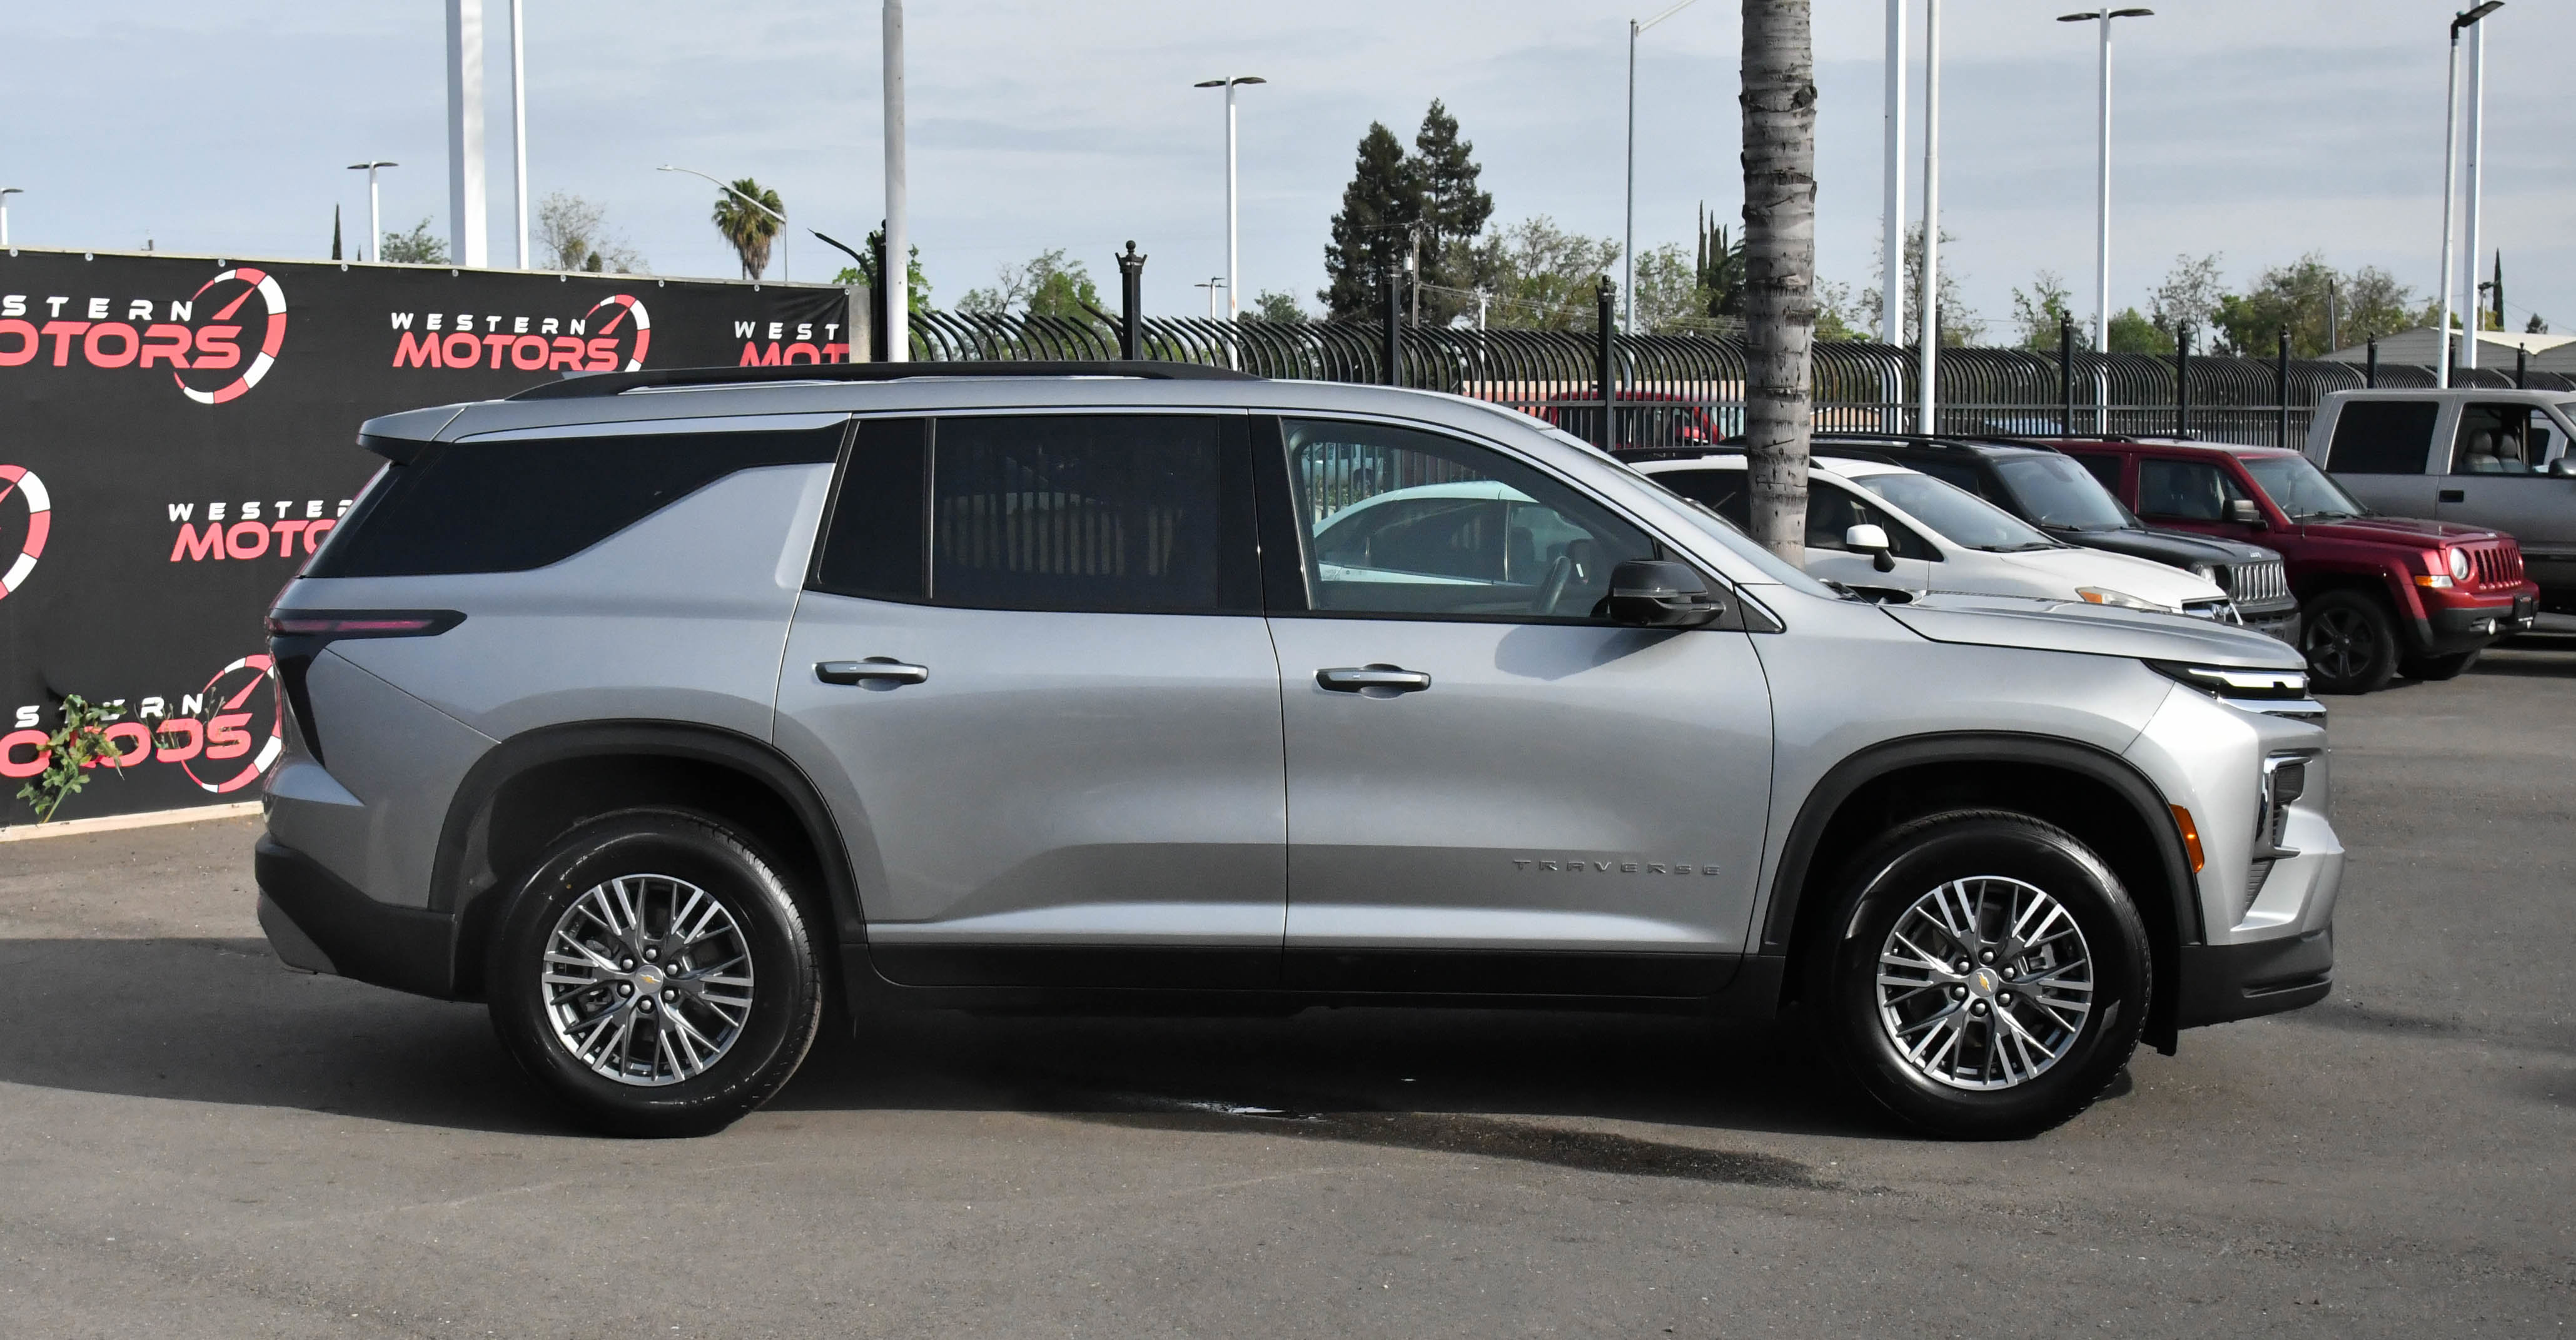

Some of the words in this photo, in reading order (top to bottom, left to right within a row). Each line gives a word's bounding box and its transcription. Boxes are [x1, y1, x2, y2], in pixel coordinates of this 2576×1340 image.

[390, 312, 586, 336] WESTERN
[734, 320, 840, 341] WEST
[391, 331, 620, 372] MOTORS
[739, 340, 850, 367] MOT
[14, 693, 204, 728] SRN
[0, 713, 253, 778] OOS
[1513, 860, 1720, 875] TRAVERSE
